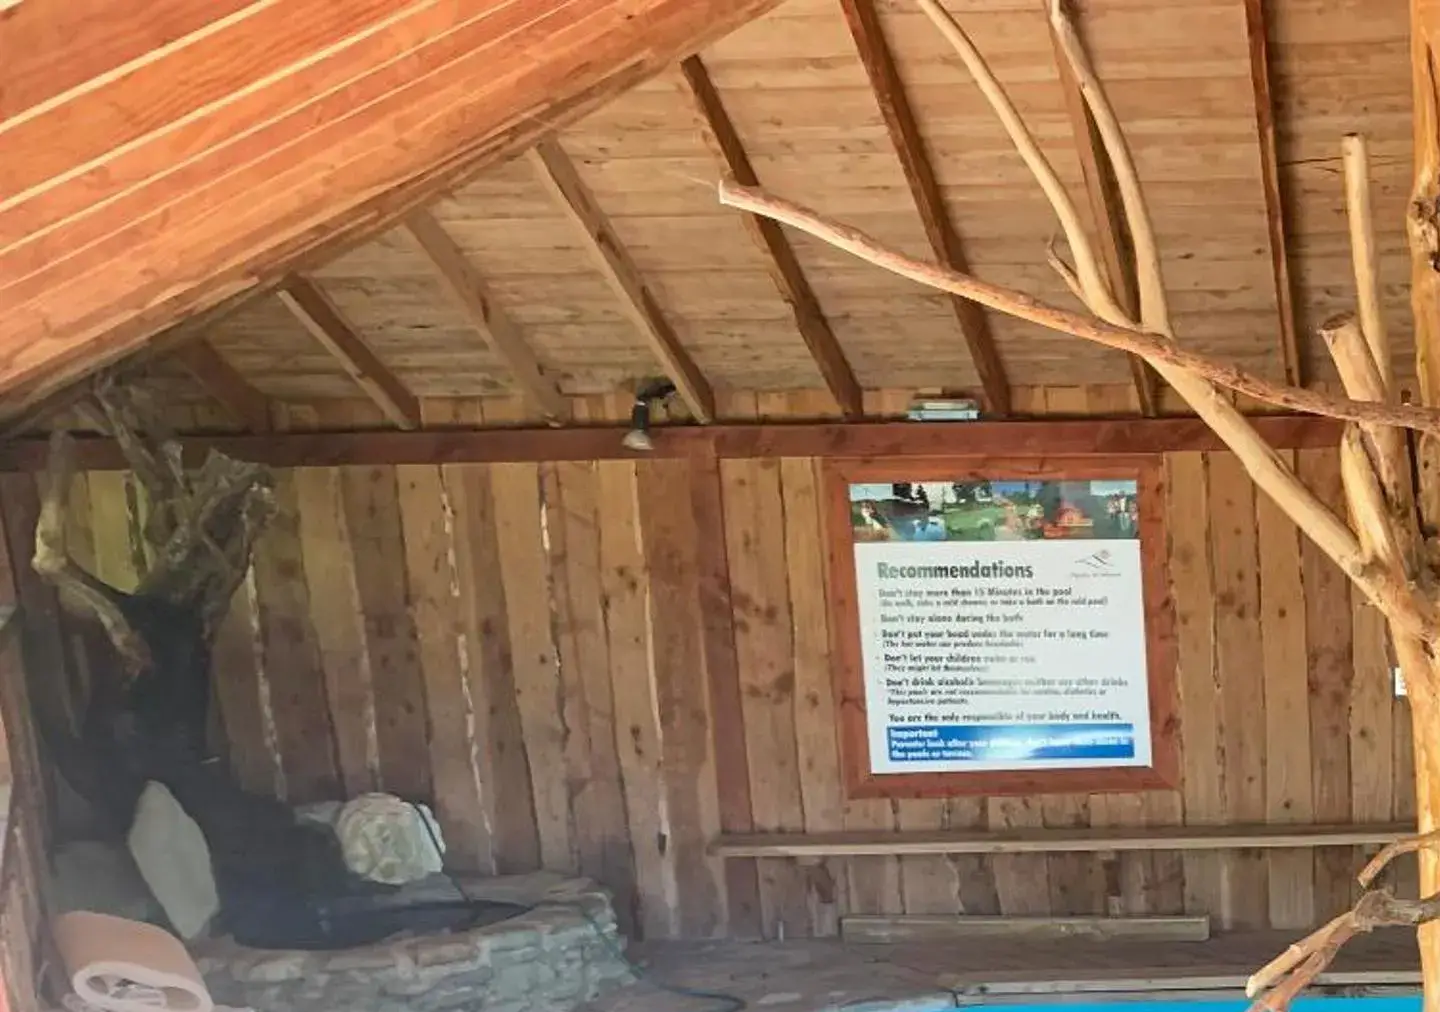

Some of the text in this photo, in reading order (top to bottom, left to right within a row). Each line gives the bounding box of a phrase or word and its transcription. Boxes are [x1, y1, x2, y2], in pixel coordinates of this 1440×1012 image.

[877, 560, 1034, 579] Recommendations
[955, 613, 984, 624] during
[945, 653, 981, 662] children
